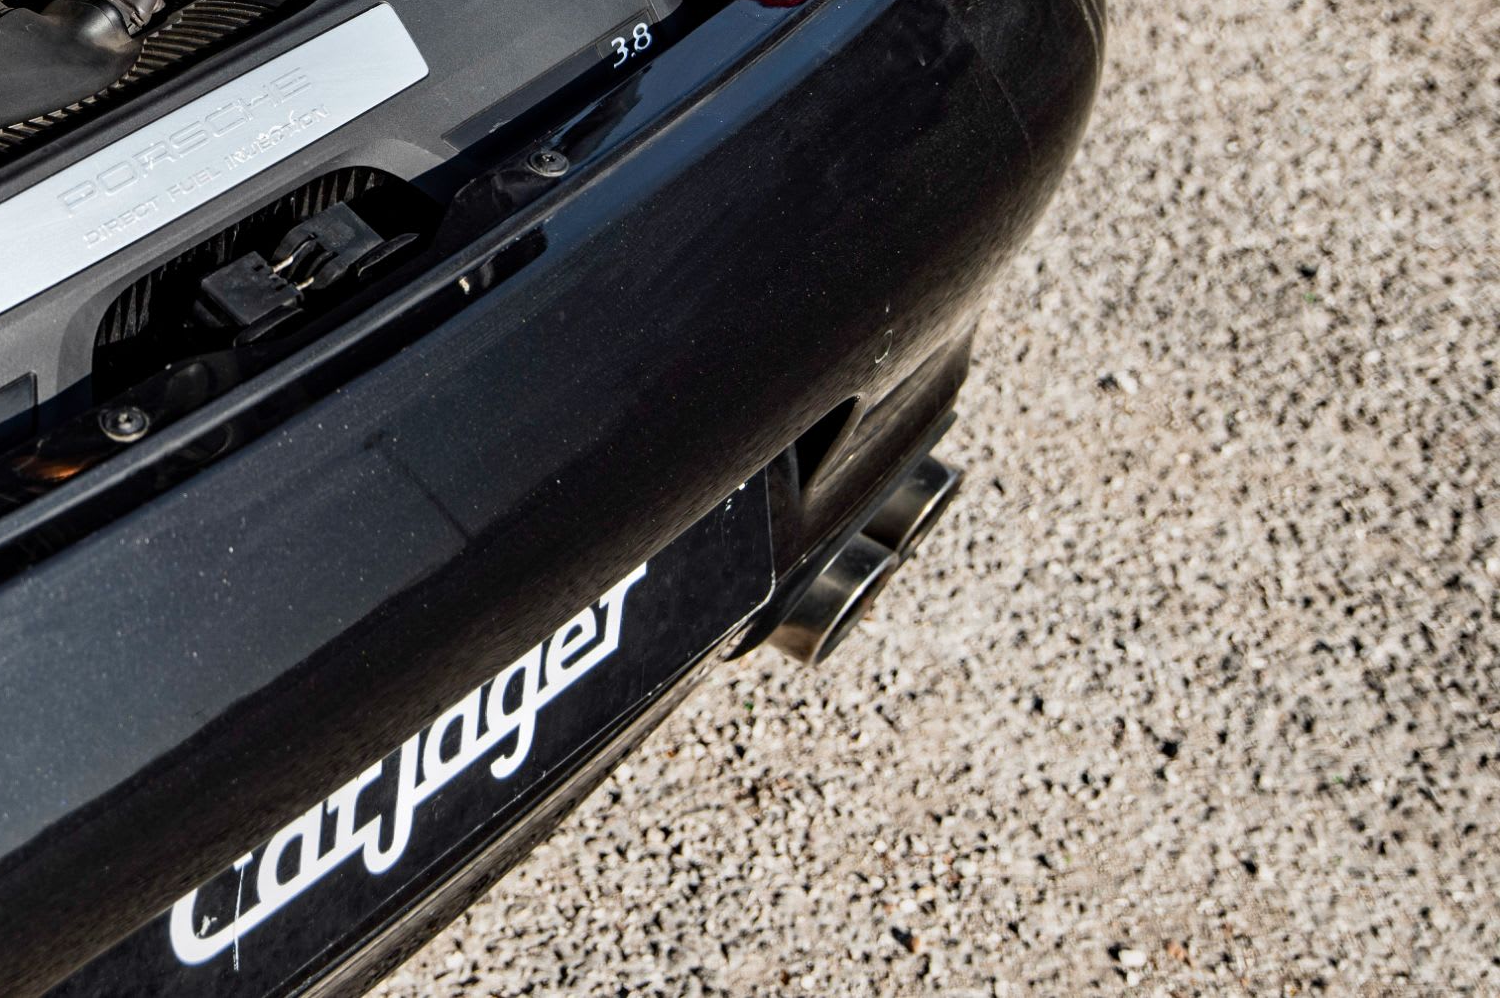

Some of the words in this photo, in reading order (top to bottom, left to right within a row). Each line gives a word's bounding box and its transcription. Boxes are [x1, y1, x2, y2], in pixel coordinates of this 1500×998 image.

[611, 22, 652, 69] 3.8
[58, 67, 312, 218] PORSCHE
[83, 195, 159, 249] DIRECT
[167, 166, 222, 203] FUEL
[226, 104, 332, 170] INJECTION
